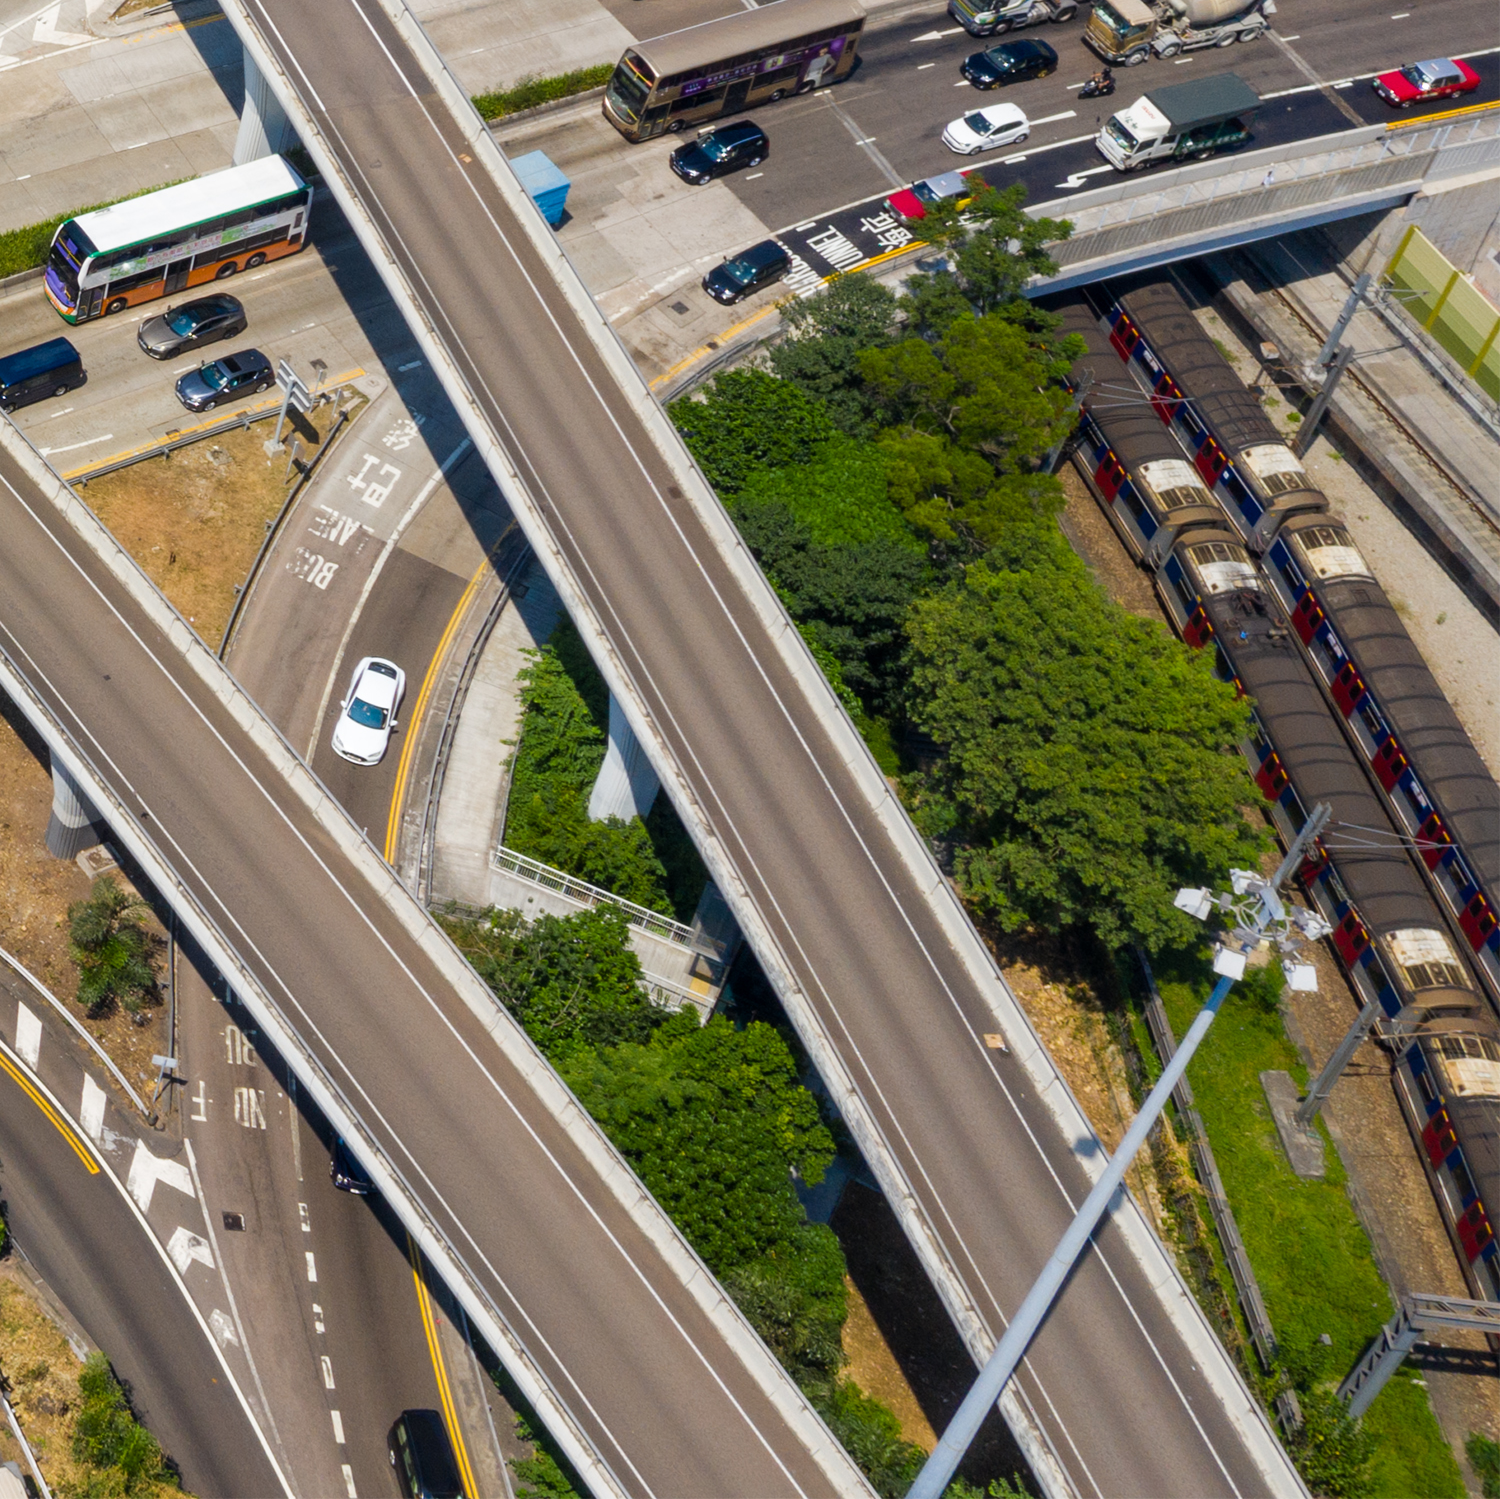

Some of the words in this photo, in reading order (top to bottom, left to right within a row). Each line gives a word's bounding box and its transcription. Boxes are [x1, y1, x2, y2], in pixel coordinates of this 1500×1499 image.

[805, 224, 871, 274] TUNNEL
[859, 211, 914, 253] 海底
[346, 452, 402, 509] 巴士
[233, 1086, 281, 1130] ND
